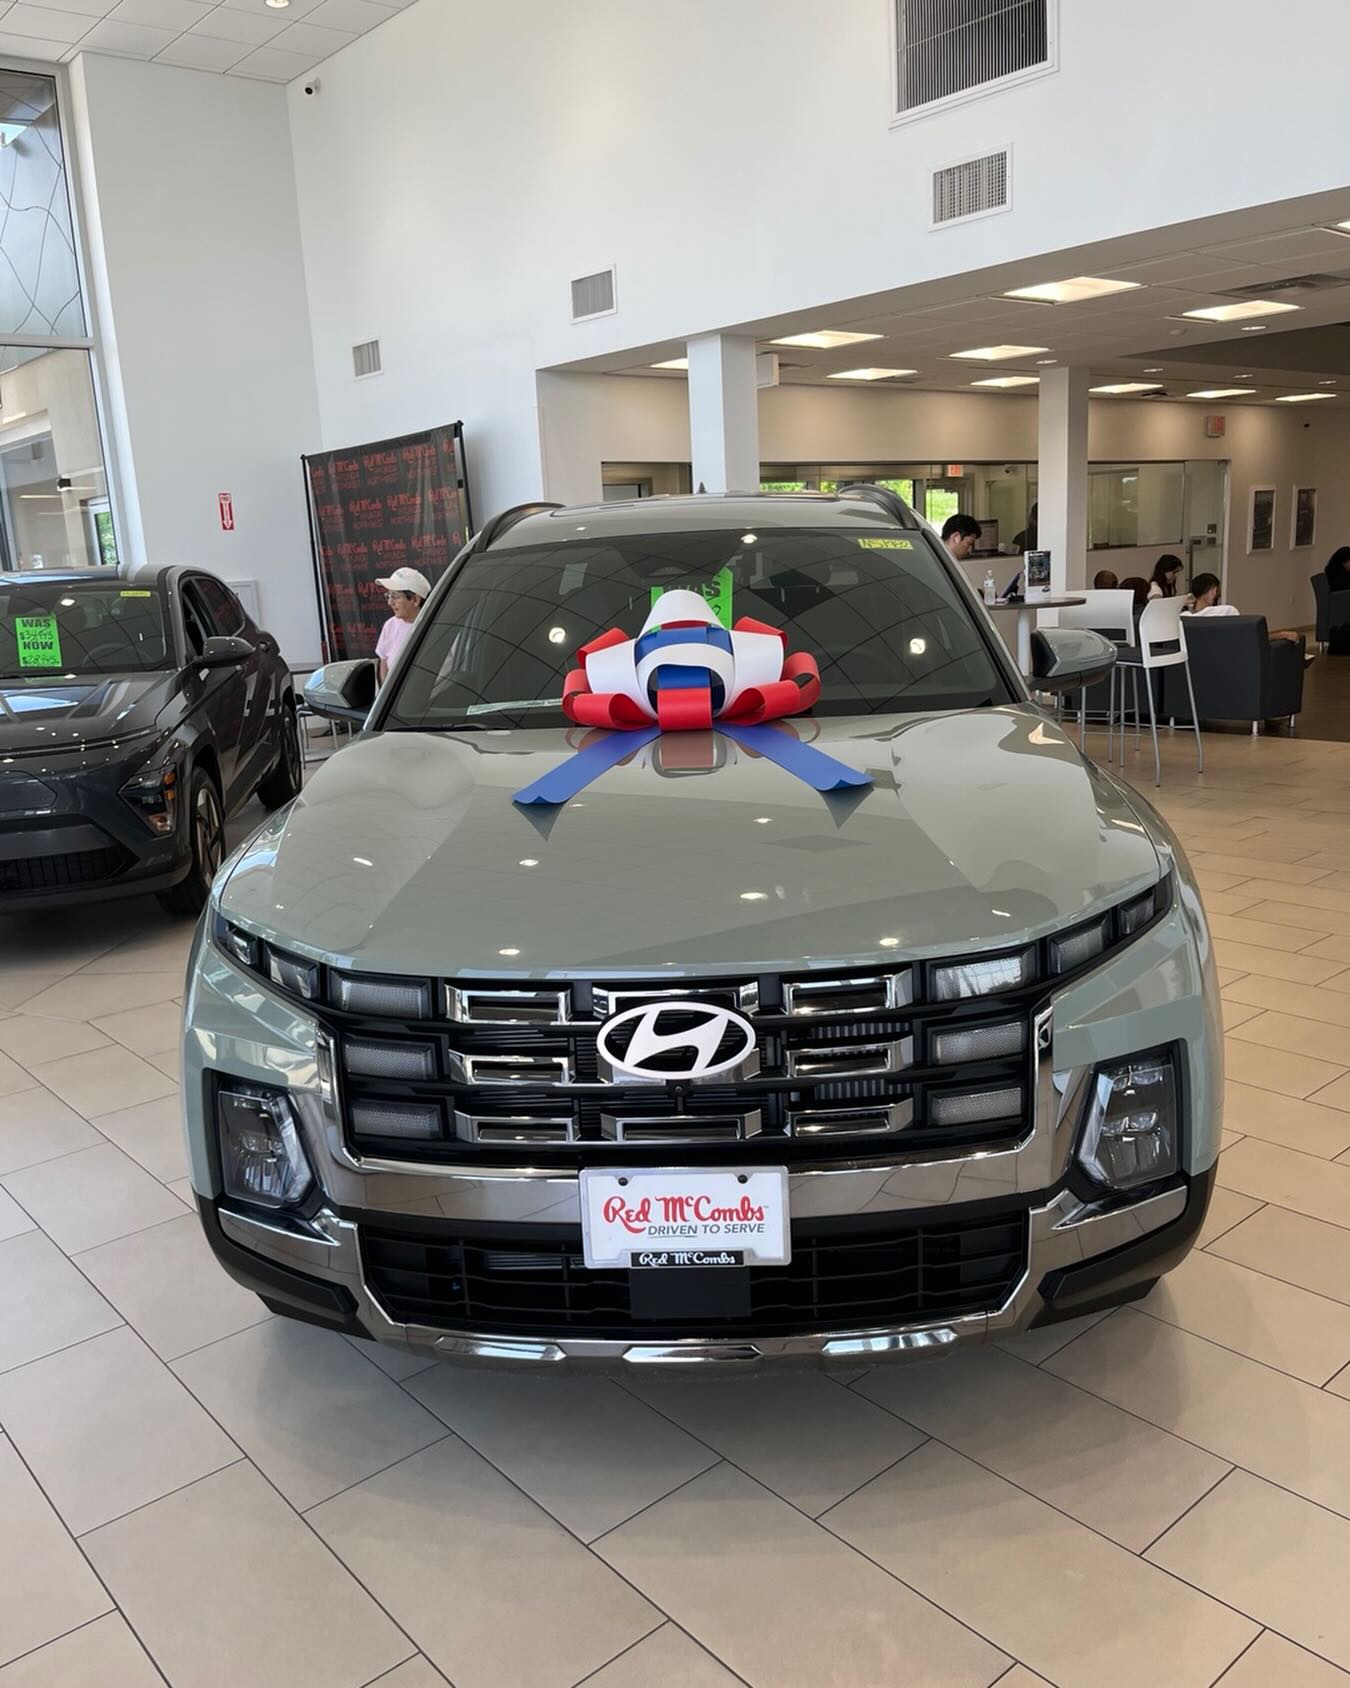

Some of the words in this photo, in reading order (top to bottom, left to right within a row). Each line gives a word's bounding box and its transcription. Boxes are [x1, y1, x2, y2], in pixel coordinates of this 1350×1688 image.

[21, 619, 51, 628] WAS
[23, 641, 53, 650] NOW
[603, 1195, 651, 1234] Red
[655, 1195, 765, 1223] McCombs
[648, 1225, 697, 1236] DRIVEN
[701, 1224, 720, 1234] TO
[724, 1223, 765, 1234] SERVE
[639, 1252, 668, 1267] Red
[670, 1252, 736, 1265] McCombs
